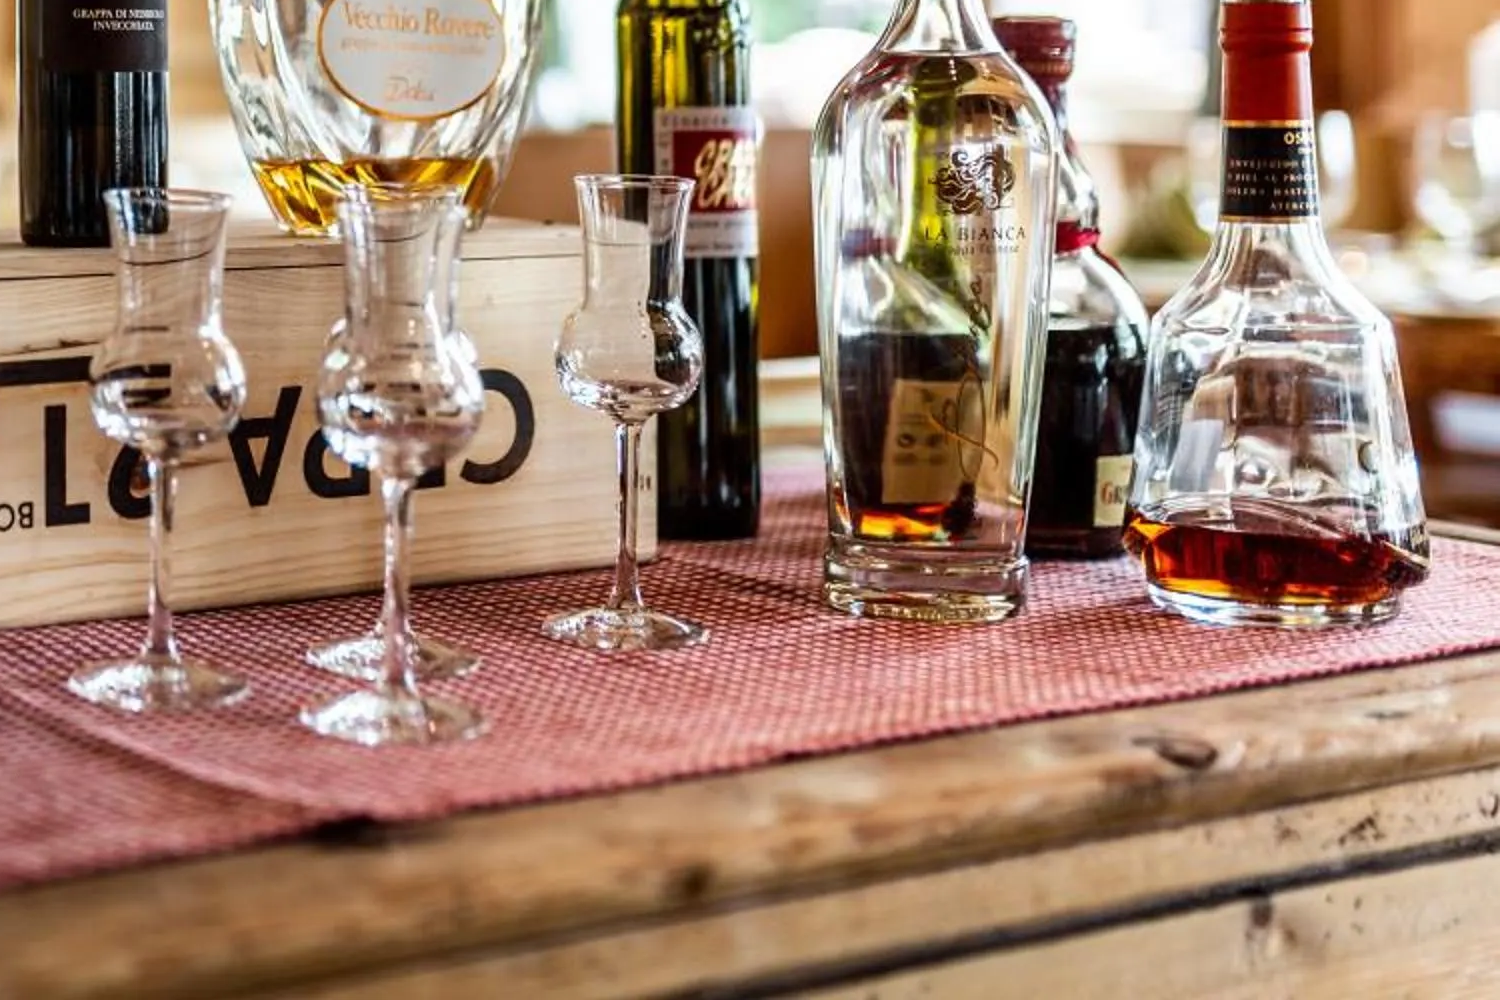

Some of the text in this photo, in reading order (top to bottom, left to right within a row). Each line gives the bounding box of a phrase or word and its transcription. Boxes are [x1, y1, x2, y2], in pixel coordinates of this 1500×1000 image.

[343, 0, 420, 33] Vecchio
[924, 225, 1026, 241] LA BIANCA
[213, 369, 534, 508] CPA
